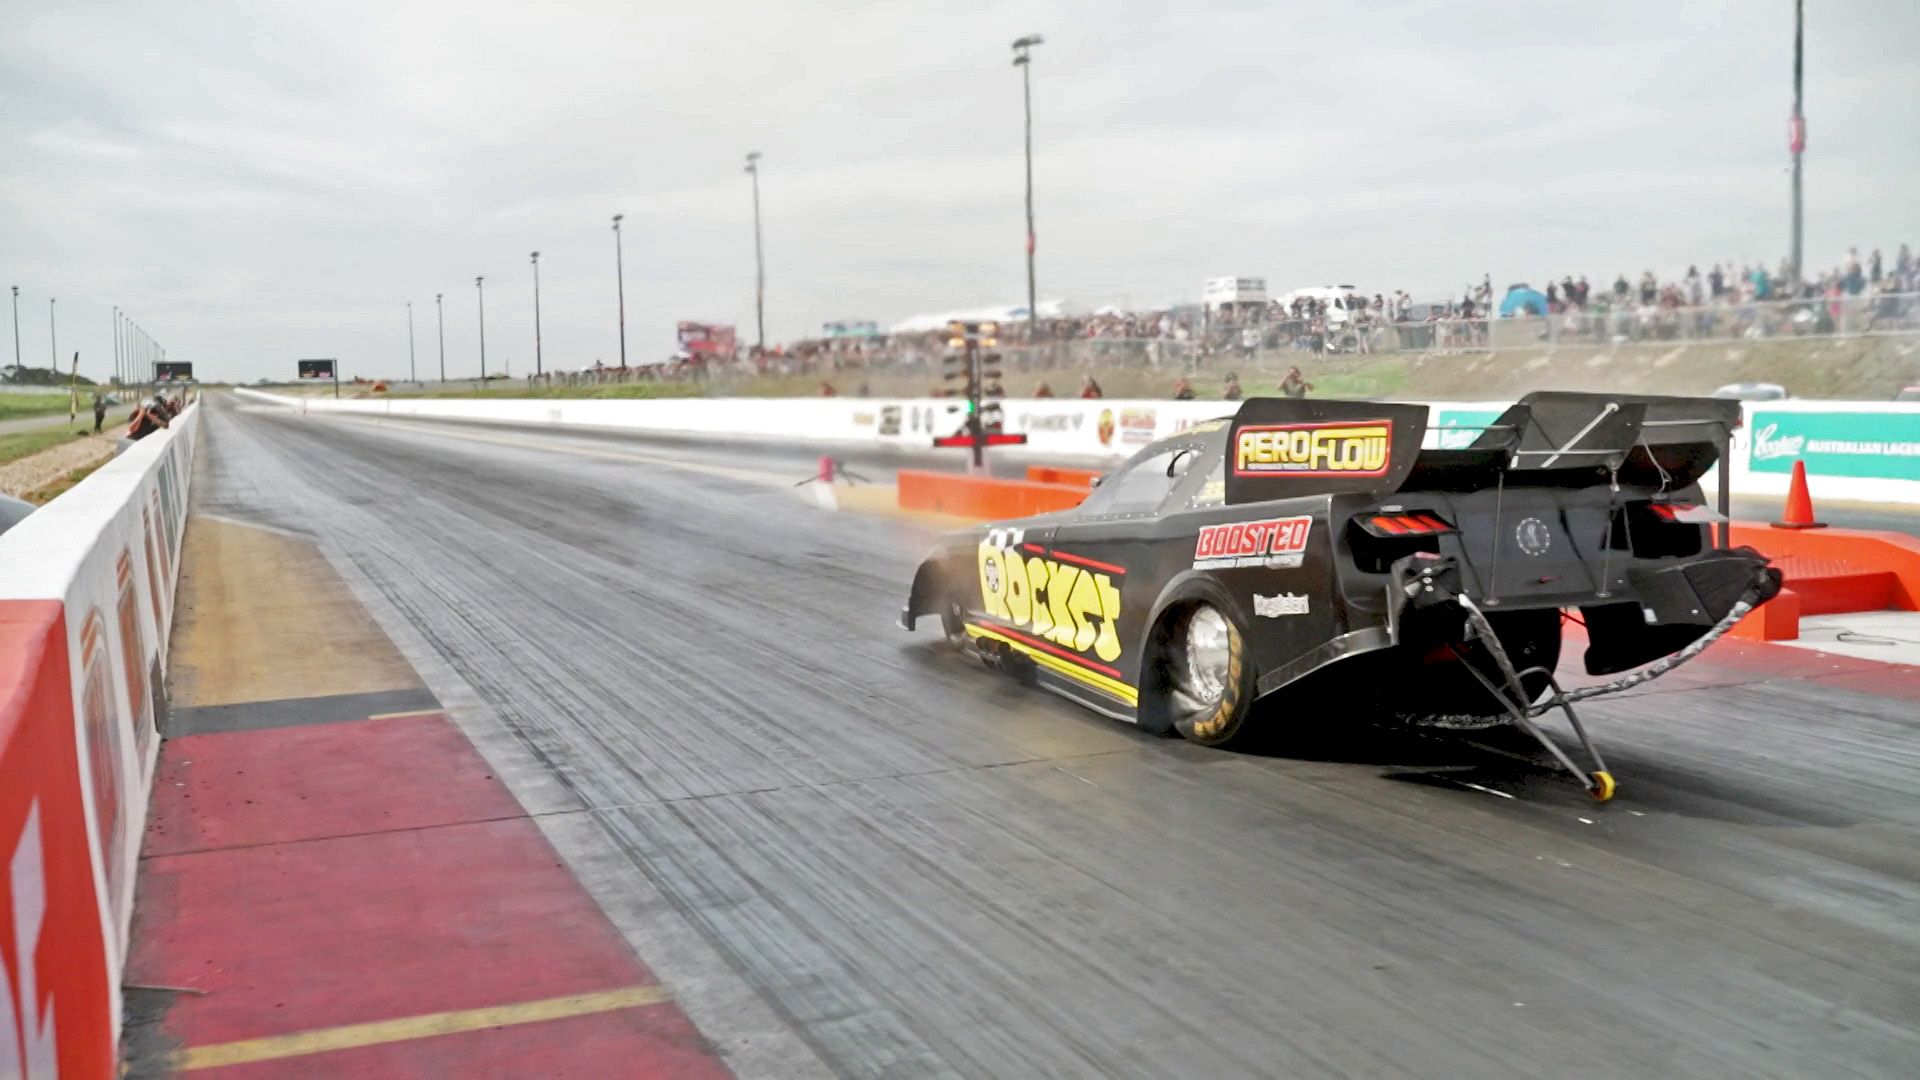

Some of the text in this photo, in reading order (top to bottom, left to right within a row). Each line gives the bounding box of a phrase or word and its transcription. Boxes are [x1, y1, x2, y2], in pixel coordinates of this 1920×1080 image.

[1238, 427, 1387, 470] AEROFLOW
[1807, 439, 1881, 455] AUSTRALIAN
[1196, 517, 1311, 558] BOOSTED
[978, 542, 1122, 662] ROCKET
